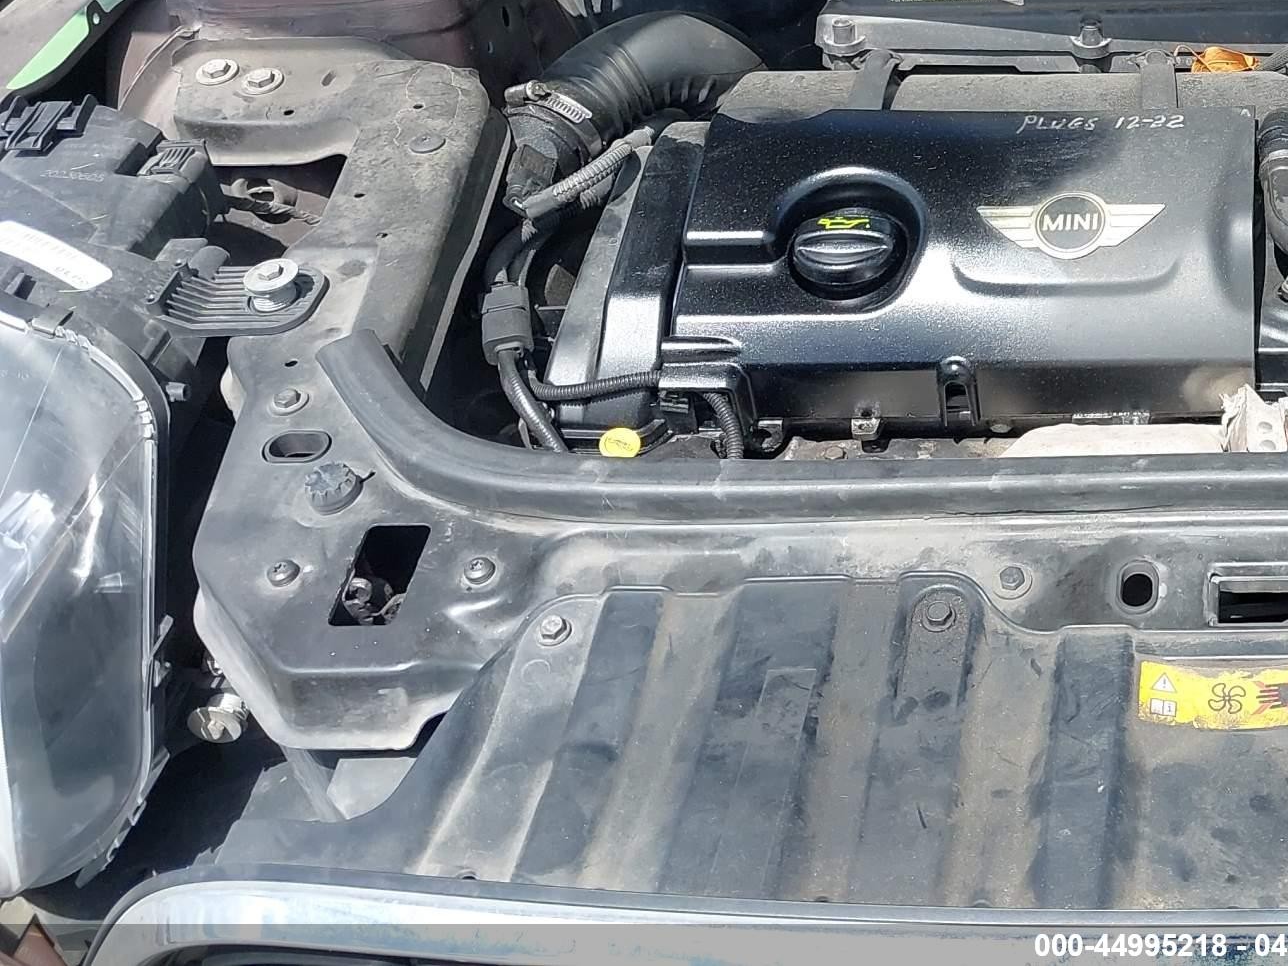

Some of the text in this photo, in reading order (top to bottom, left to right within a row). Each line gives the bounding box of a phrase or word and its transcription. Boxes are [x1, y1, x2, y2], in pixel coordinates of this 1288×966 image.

[1016, 114, 1184, 134] PLUGS 12-22
[1042, 213, 1099, 232] MINI
